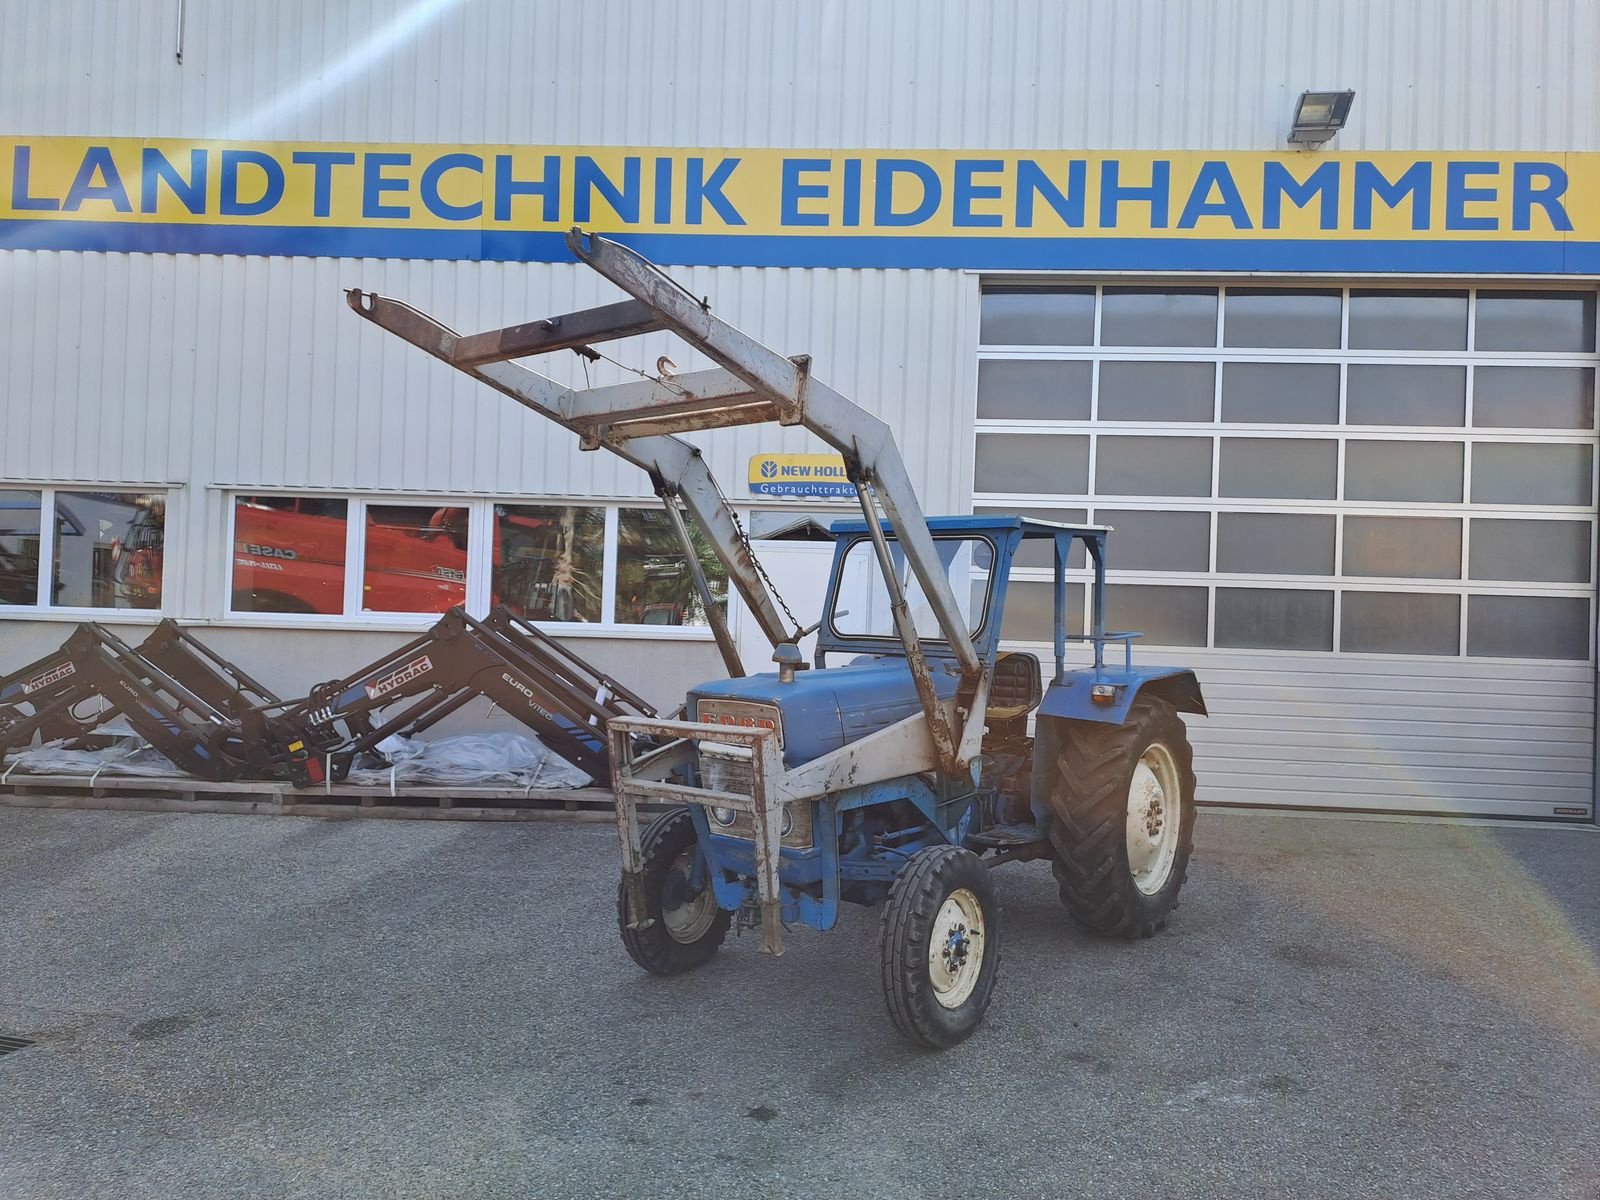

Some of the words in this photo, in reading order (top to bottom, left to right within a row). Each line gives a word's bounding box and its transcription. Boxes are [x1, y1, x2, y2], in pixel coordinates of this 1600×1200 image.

[12, 145, 747, 226] LANDTECHNIK
[779, 157, 1575, 233] EIDENHAMMER
[781, 465, 811, 477] NEW
[813, 466, 846, 477] HOLL
[760, 483, 875, 496] Gebrauchttrakte
[31, 667, 73, 690] HYDRAC
[119, 679, 139, 697] EURO
[378, 663, 430, 693] HYDRAC
[502, 672, 534, 698] EURO
[703, 713, 775, 730] FORD
